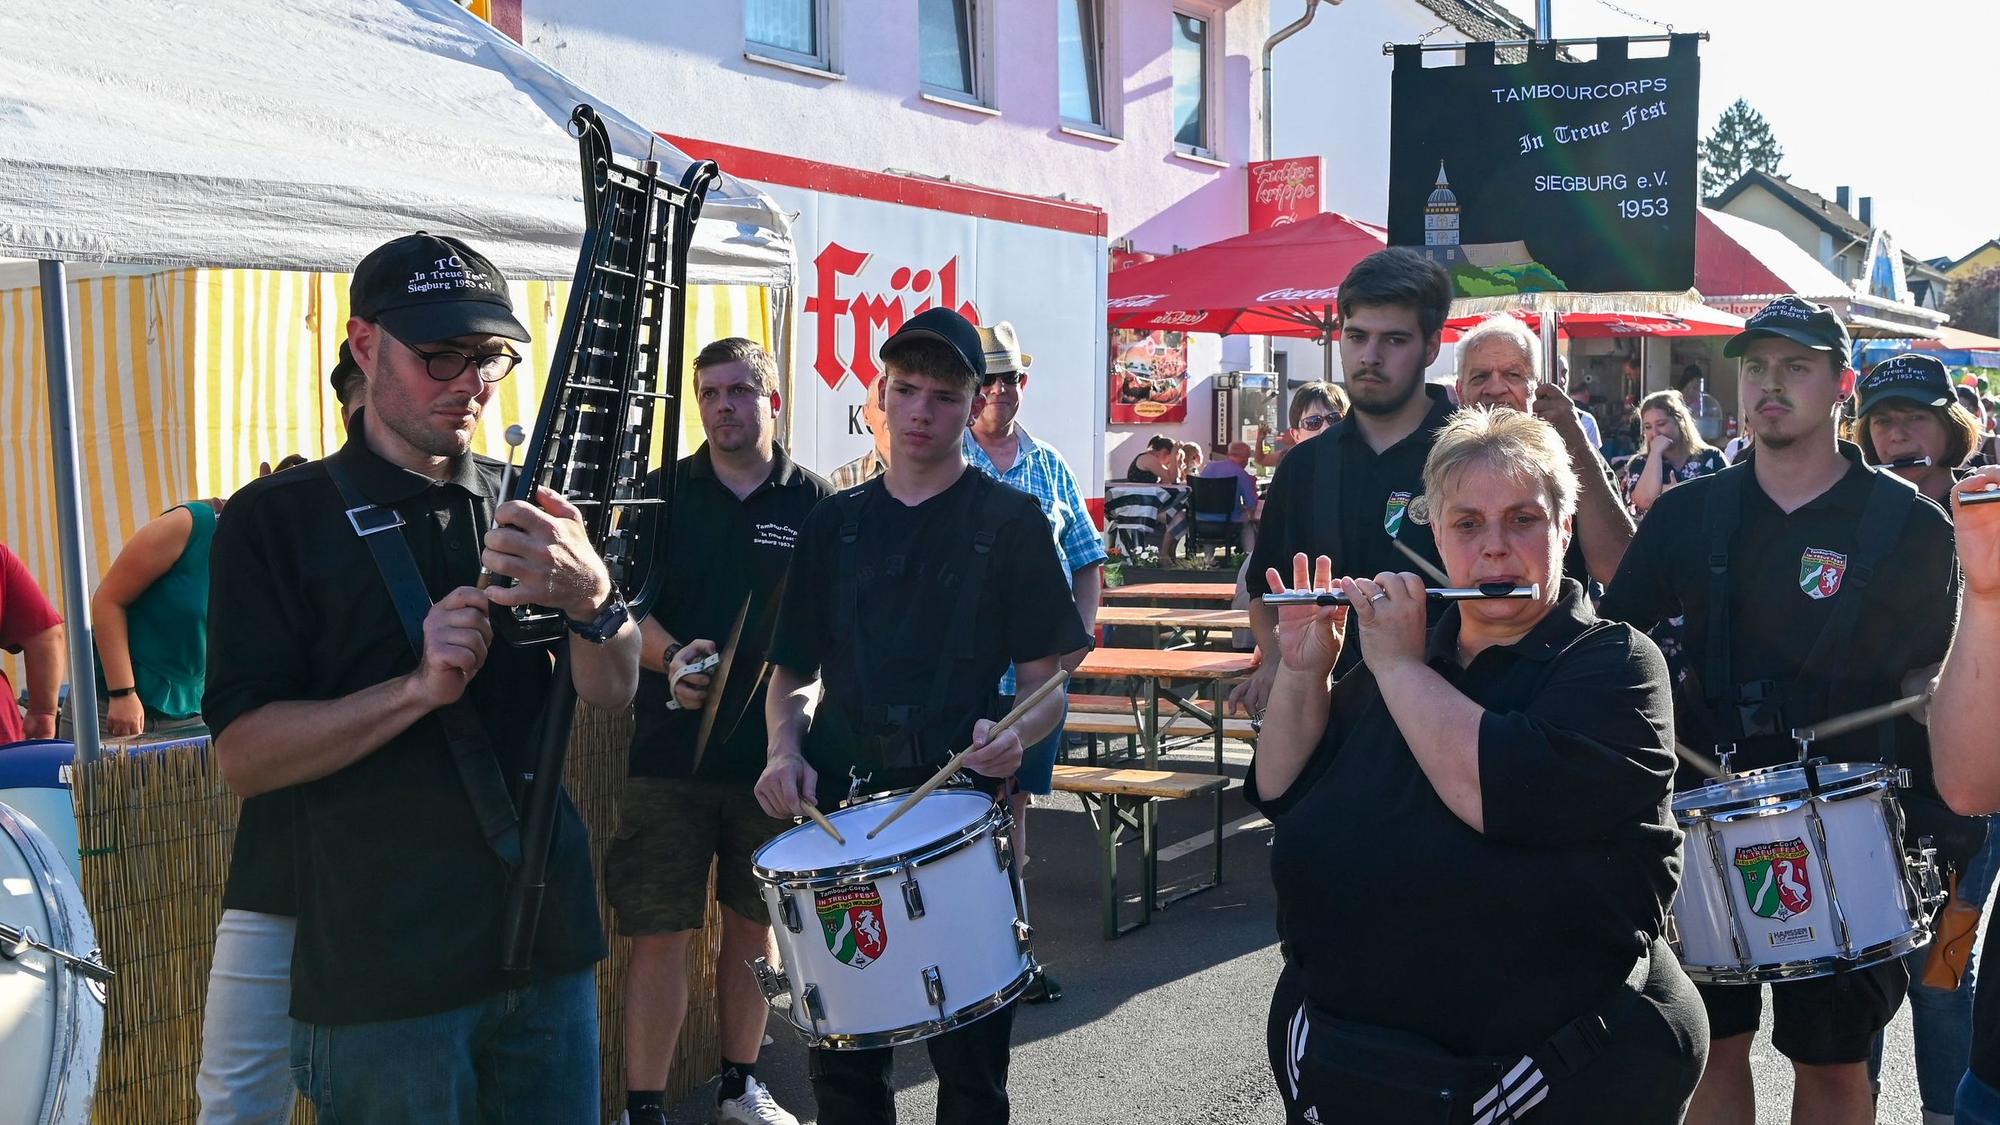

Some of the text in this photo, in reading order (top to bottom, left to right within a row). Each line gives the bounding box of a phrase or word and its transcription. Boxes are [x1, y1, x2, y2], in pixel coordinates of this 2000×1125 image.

[1492, 78, 1668, 103] TAMBOURCORPS
[1518, 99, 1668, 156] In Treue Fest
[1534, 170, 1668, 192] SIEGBURG e.V.
[1617, 198, 1669, 219] 1953
[434, 255, 462, 270] TC
[430, 270, 463, 280] Treue
[407, 279, 451, 293] Siegburg
